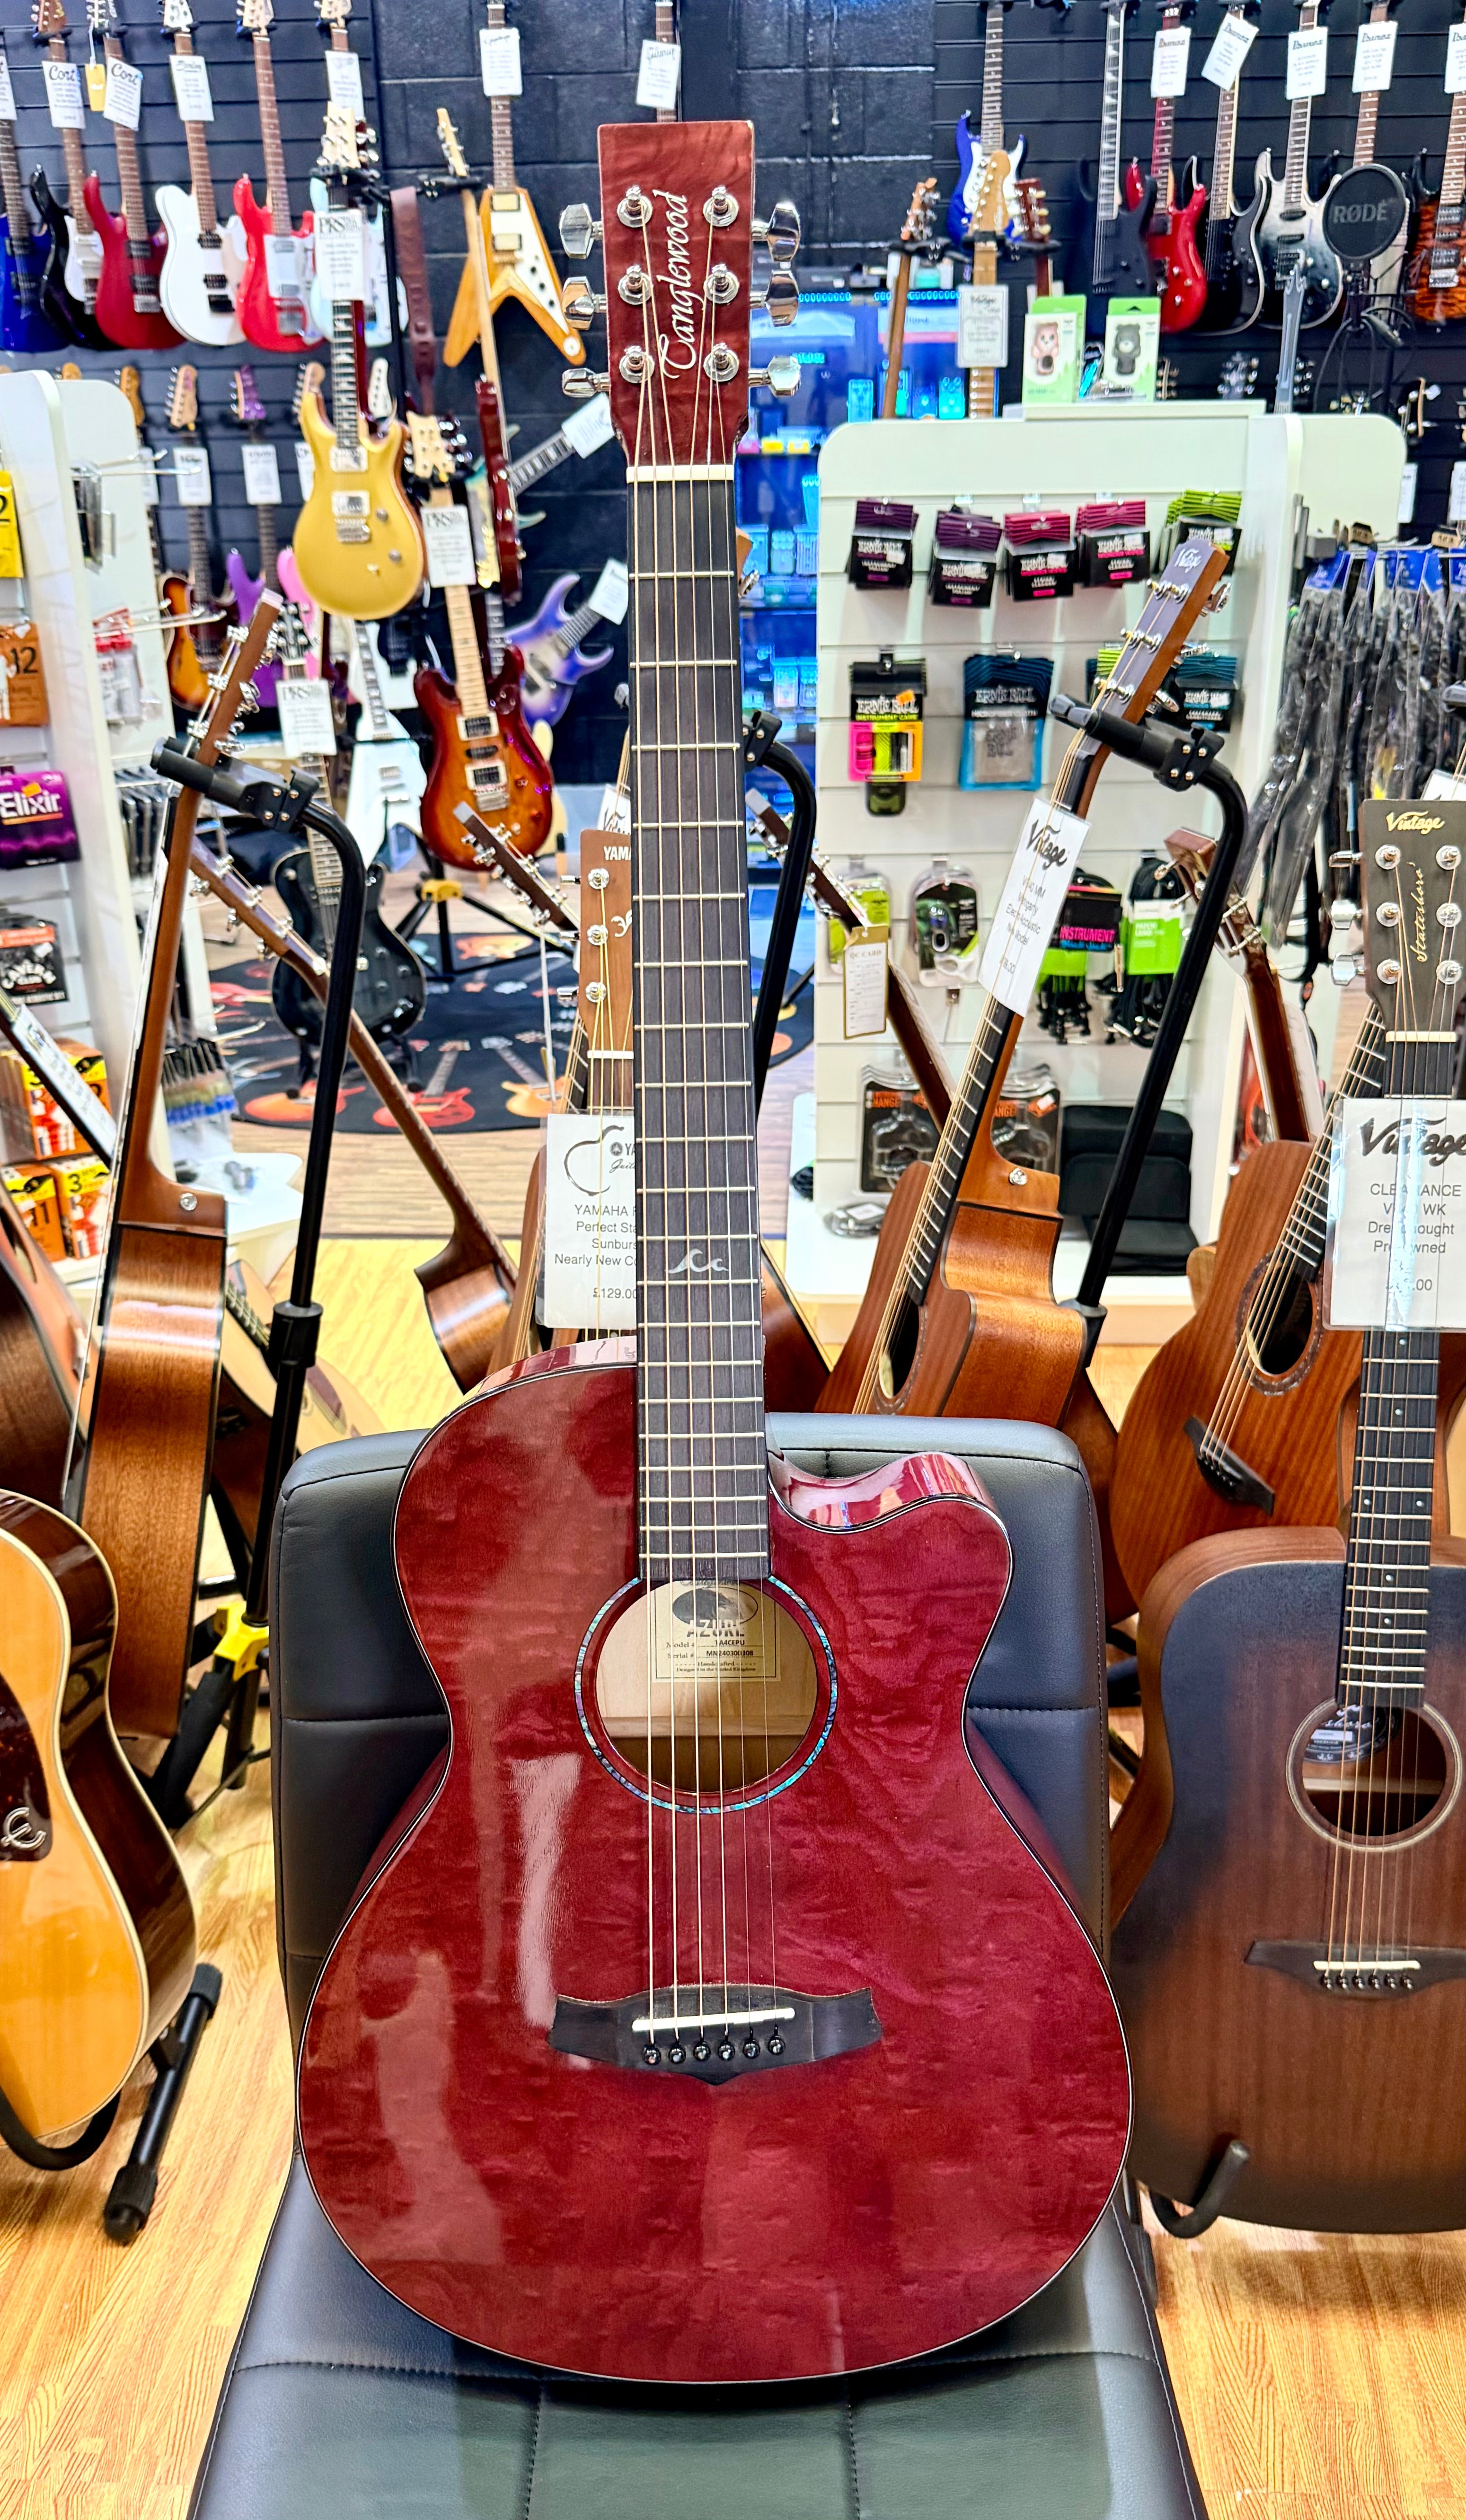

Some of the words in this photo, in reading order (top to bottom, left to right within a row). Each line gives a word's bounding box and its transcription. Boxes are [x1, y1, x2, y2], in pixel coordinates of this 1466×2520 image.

[652, 189, 707, 379] Tanglewood
[0, 789, 60, 818] Elixir
[1386, 811, 1445, 835] Vintage
[1060, 925, 1115, 943] INSTRUMENT
[1370, 1183, 1462, 1197] CLEAANCE
[574, 1204, 628, 1216] YAMAHA
[576, 1221, 617, 1233] Perfect
[555, 1254, 592, 1267] Nearly
[596, 1254, 621, 1265] New
[687, 1619, 745, 1637] AZURE
